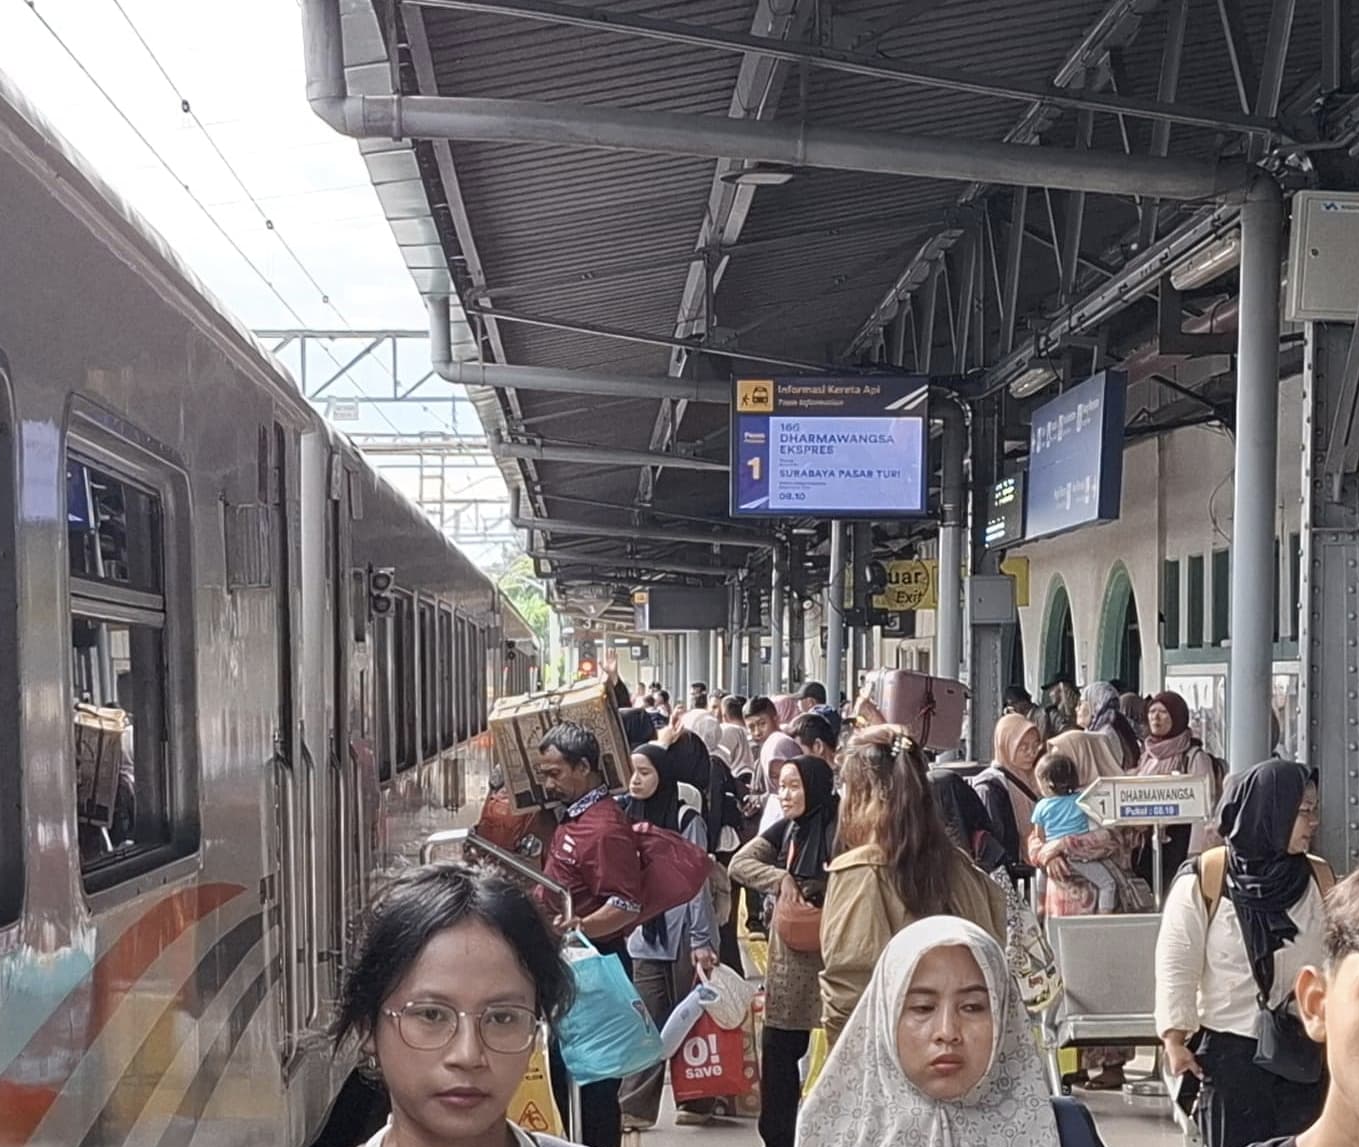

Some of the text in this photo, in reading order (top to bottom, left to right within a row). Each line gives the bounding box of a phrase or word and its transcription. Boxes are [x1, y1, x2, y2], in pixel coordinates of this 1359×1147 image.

[777, 384, 881, 397] Informasi Kereta Api
[779, 433, 896, 445] DHARMAWANGSA
[779, 445, 835, 455] EKSPRES
[746, 456, 762, 481] 1
[779, 469, 901, 479] SURABAYA PASAR TURI
[895, 590, 925, 604] Exit
[1120, 787, 1195, 802] DHARMAWANGSA
[1098, 798, 1107, 816] 1
[685, 1064, 723, 1079] save
